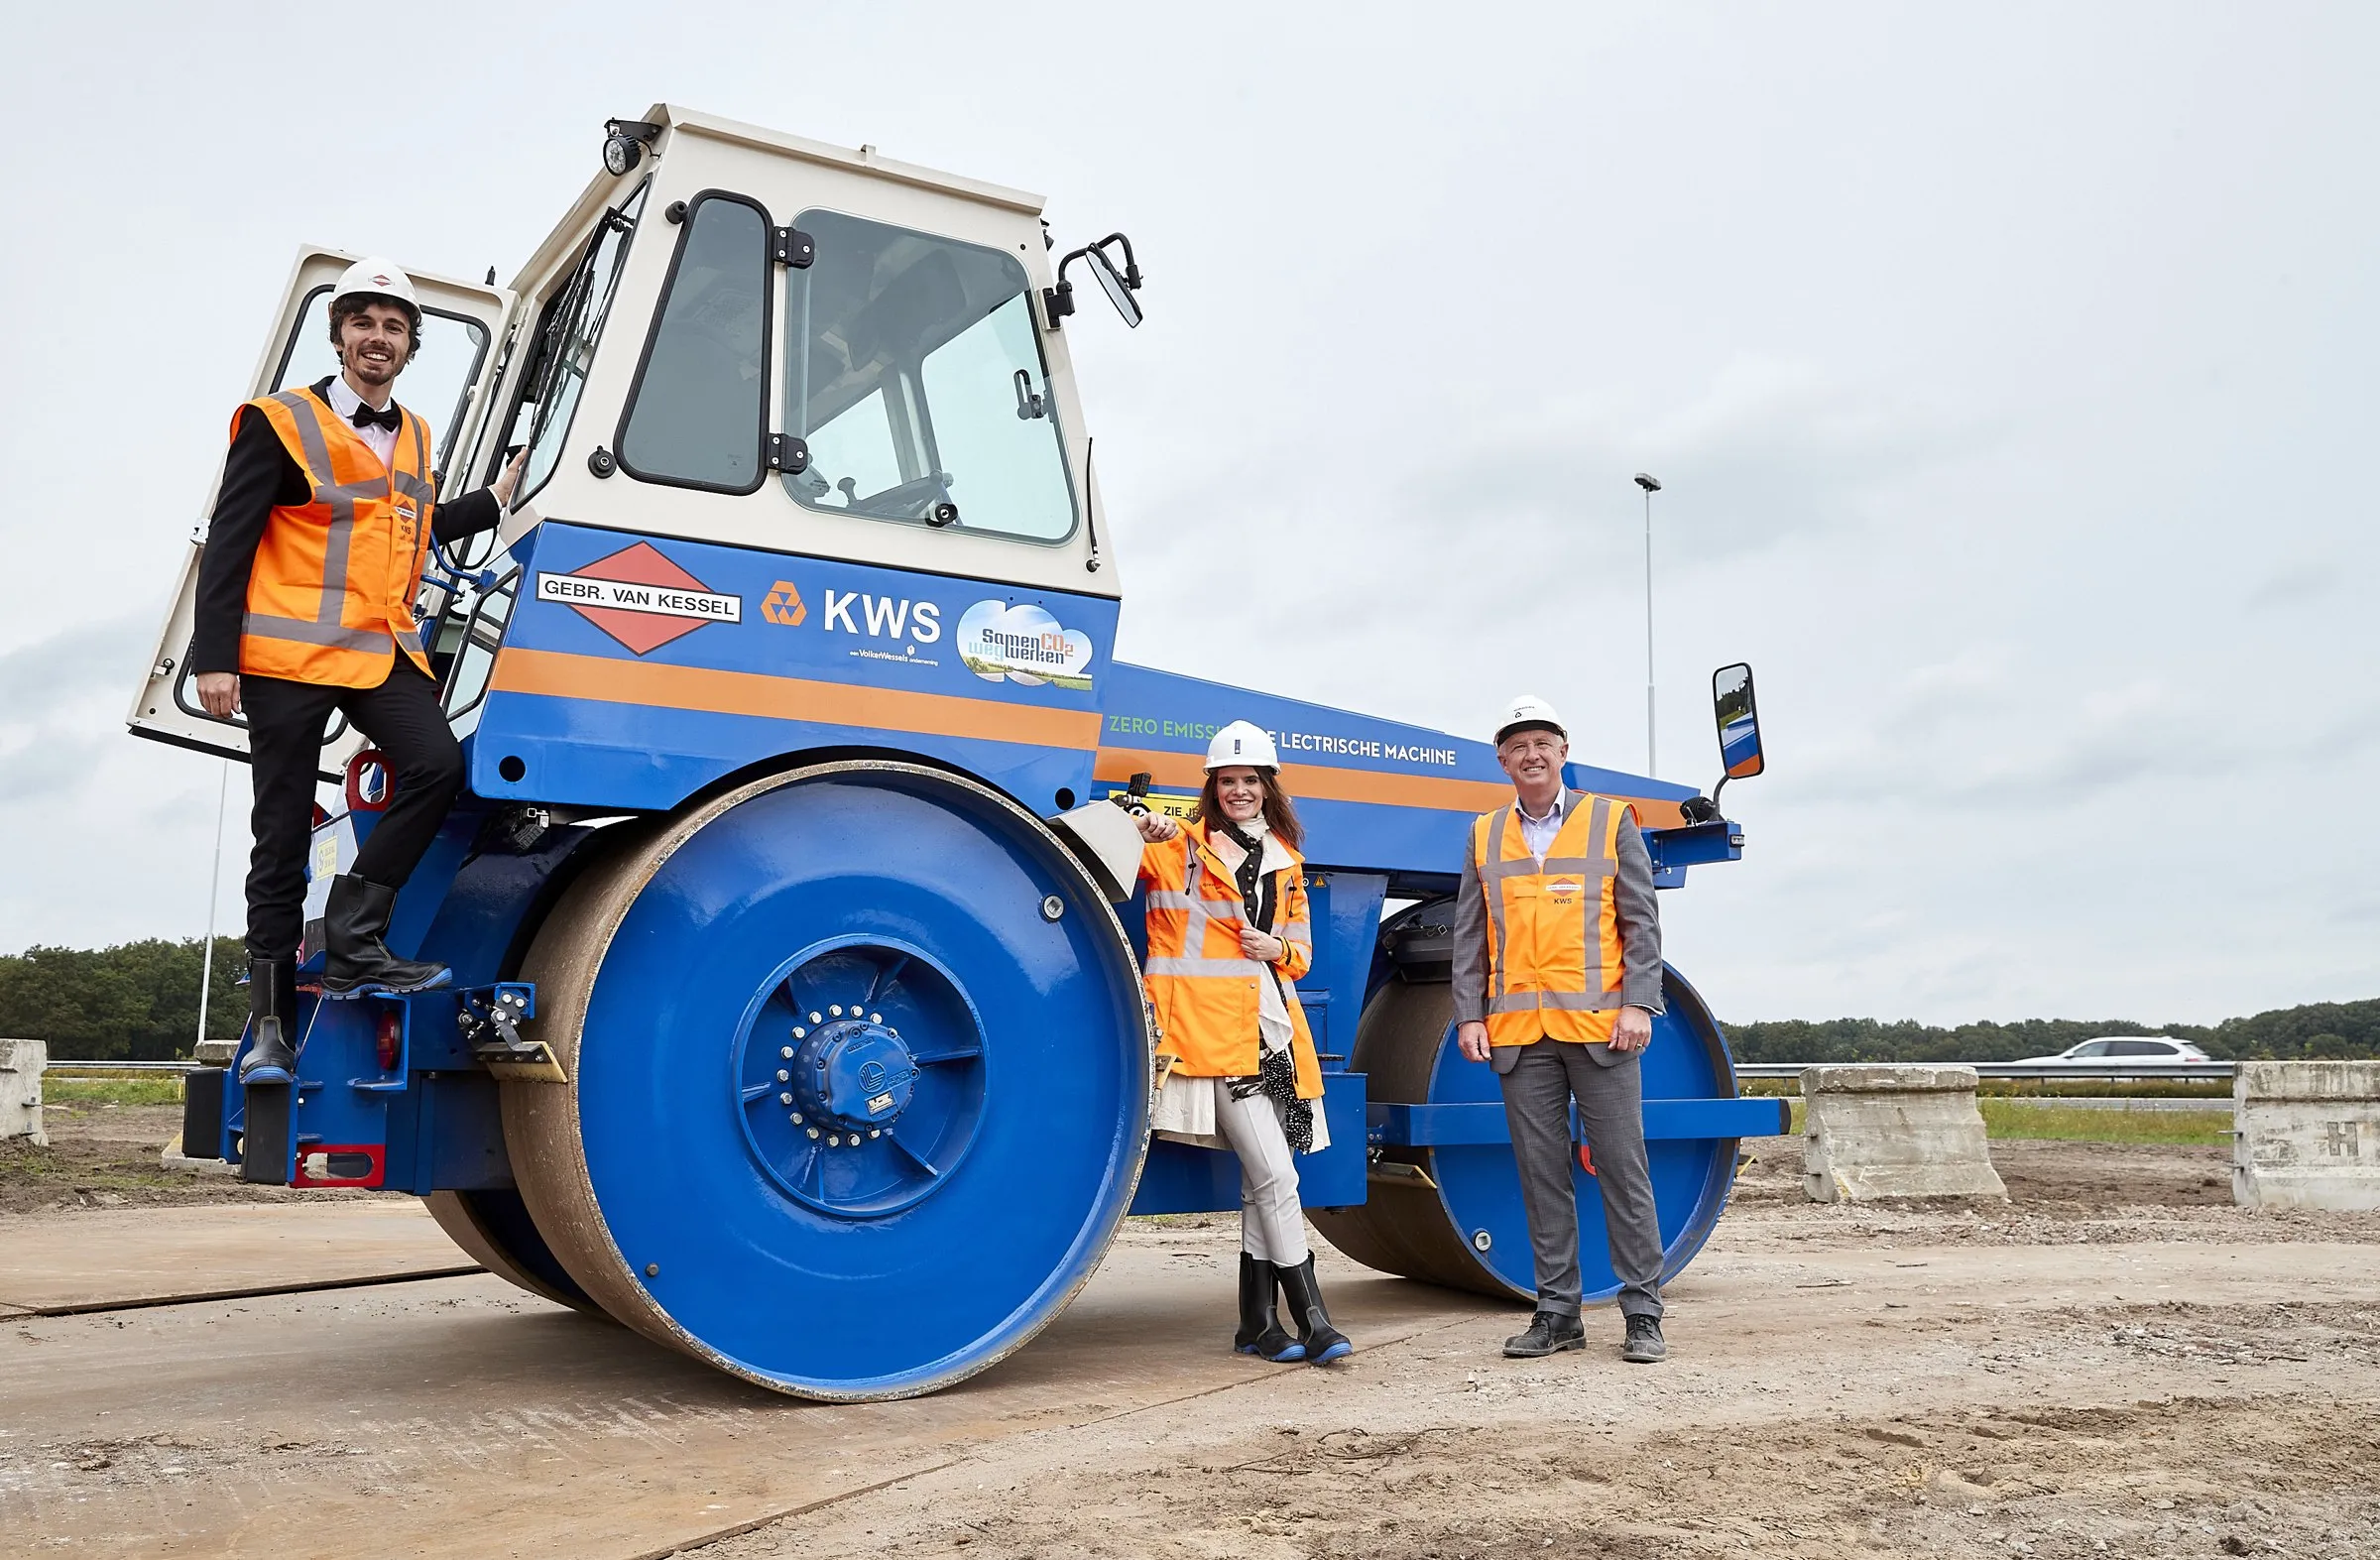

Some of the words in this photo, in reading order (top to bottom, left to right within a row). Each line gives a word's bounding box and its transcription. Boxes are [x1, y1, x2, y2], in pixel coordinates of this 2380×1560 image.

[544, 580, 605, 600] GEBR.
[613, 588, 650, 605] VAN
[658, 594, 735, 616] KESSEL
[824, 589, 941, 644] KWS
[1109, 715, 1158, 735] ZERO
[1384, 744, 1457, 766] MACHINE
[1163, 805, 1182, 817] ZIE
[2326, 1121, 2359, 1156] H
